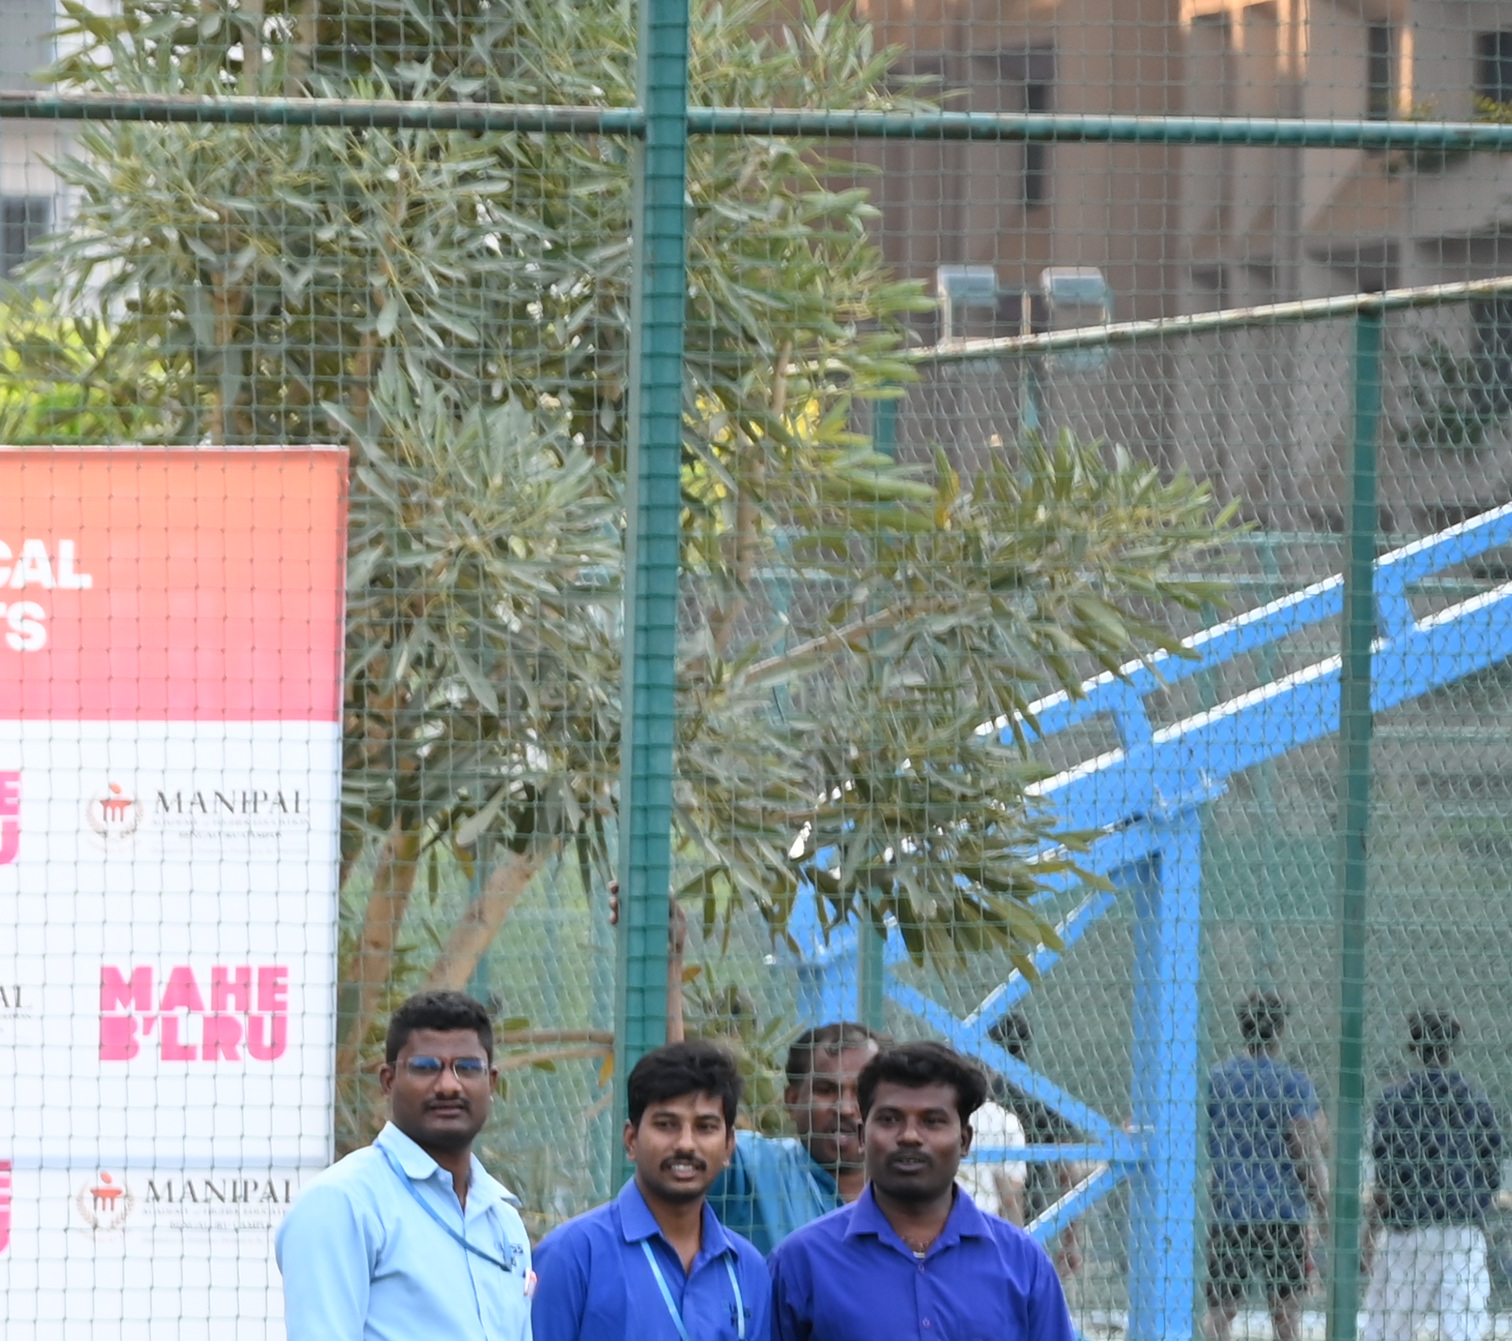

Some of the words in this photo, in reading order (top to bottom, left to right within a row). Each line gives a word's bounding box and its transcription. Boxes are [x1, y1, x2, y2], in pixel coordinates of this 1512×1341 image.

[154, 789, 310, 814] MANIPAL
[102, 968, 288, 1013] MAHE
[101, 1016, 288, 1062] B'LRU
